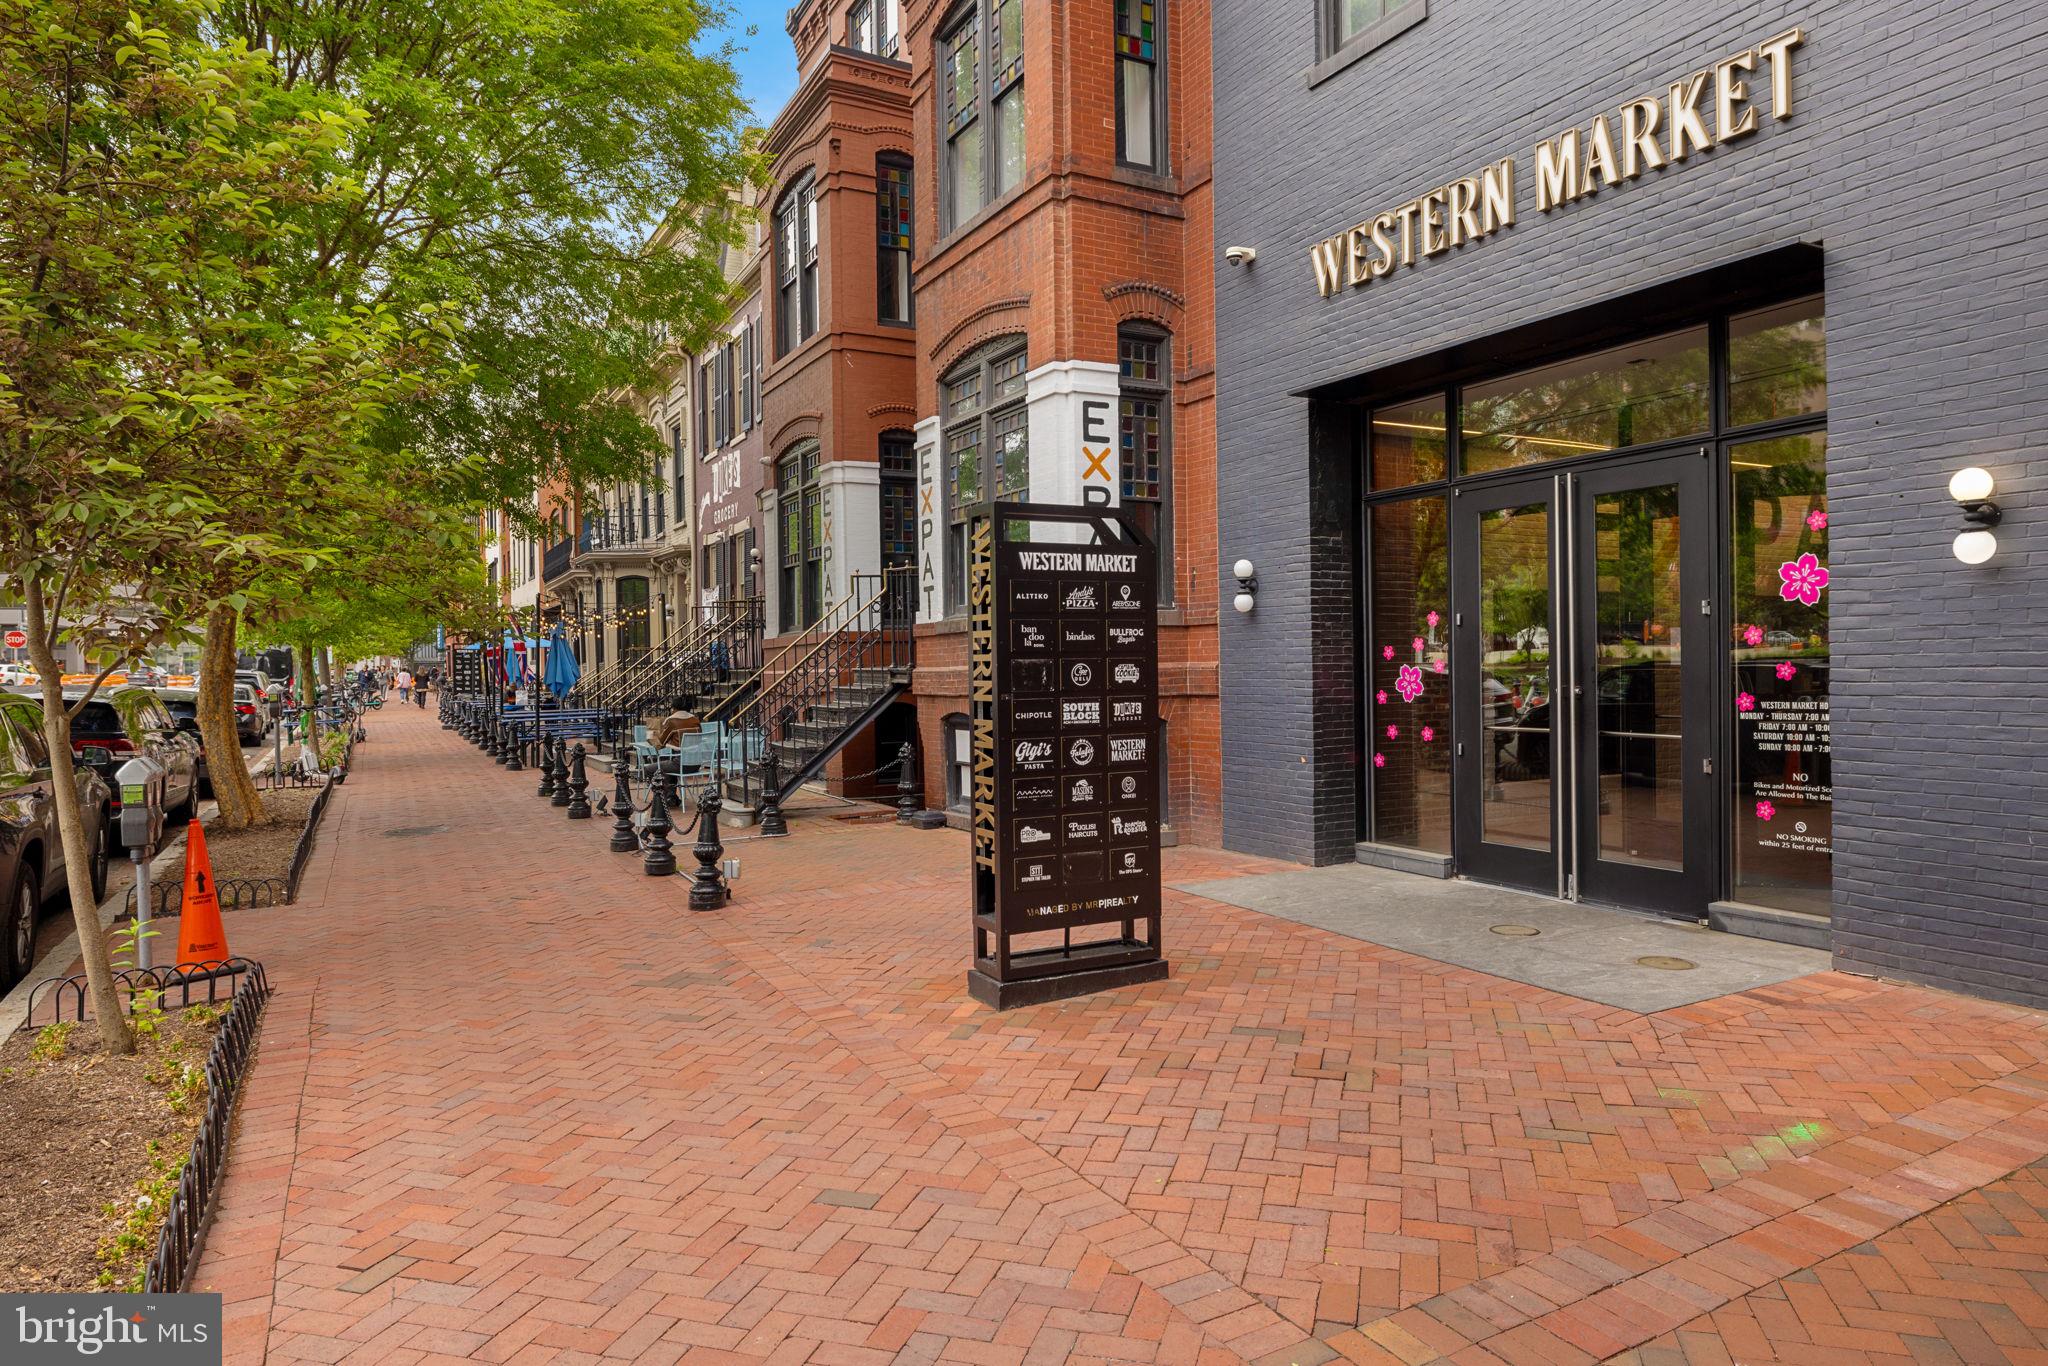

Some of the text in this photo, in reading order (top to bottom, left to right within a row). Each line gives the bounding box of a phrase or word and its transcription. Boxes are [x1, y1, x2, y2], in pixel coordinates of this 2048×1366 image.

[1309, 28, 1804, 298] WESTERN MARKET
[714, 502, 739, 525] GROCERY
[920, 448, 934, 620] EXPAT
[823, 488, 833, 630] EXPAT
[1019, 552, 1137, 573] WESTERN MARKET
[971, 521, 993, 702] WESTERN
[1021, 624, 1037, 633] ban
[1109, 628, 1144, 636] BULLFROG
[6, 636, 25, 644] STOP
[1028, 632, 1044, 641] doo
[1066, 631, 1095, 641] bindaas
[1024, 638, 1032, 647] la
[1063, 702, 1100, 712] SOUTH
[1760, 701, 1790, 709] WESTERN
[1791, 701, 1818, 710] MARKET
[1015, 711, 1053, 719] CHIPOTLE
[1063, 712, 1100, 721] BLOCK
[1740, 712, 1764, 720] MONDAY
[1771, 712, 1803, 720] THURSDAY
[1804, 713, 1819, 721] 7:00
[1758, 723, 1780, 731] FRIDAY
[1781, 723, 1796, 731] 7:00
[1797, 724, 1808, 732] AM
[1753, 732, 1784, 741] SATURDAY
[1786, 733, 1803, 741] 10:00
[1804, 734, 1815, 742] AM
[1110, 739, 1145, 750] WESTERN
[1758, 742, 1782, 751] SUNDAY
[1784, 744, 1801, 752] 10:00
[1015, 741, 1053, 761] Gigi's
[1111, 750, 1141, 761] MARKET
[1792, 772, 1809, 782] NO
[1753, 781, 1771, 789] Bikes
[1785, 784, 1820, 792] Motorized
[974, 719, 996, 874] MARKET
[1768, 791, 1795, 799] Allowed
[1068, 822, 1097, 831] PUGLISI
[1068, 830, 1098, 838] HAIRCUTS
[1790, 834, 1827, 845] SMOKING
[1758, 840, 1780, 848] within
[1781, 841, 1790, 849] 25
[1791, 843, 1805, 851] feet
[1027, 904, 1069, 917] MANAGED
[1071, 902, 1083, 911] BY
